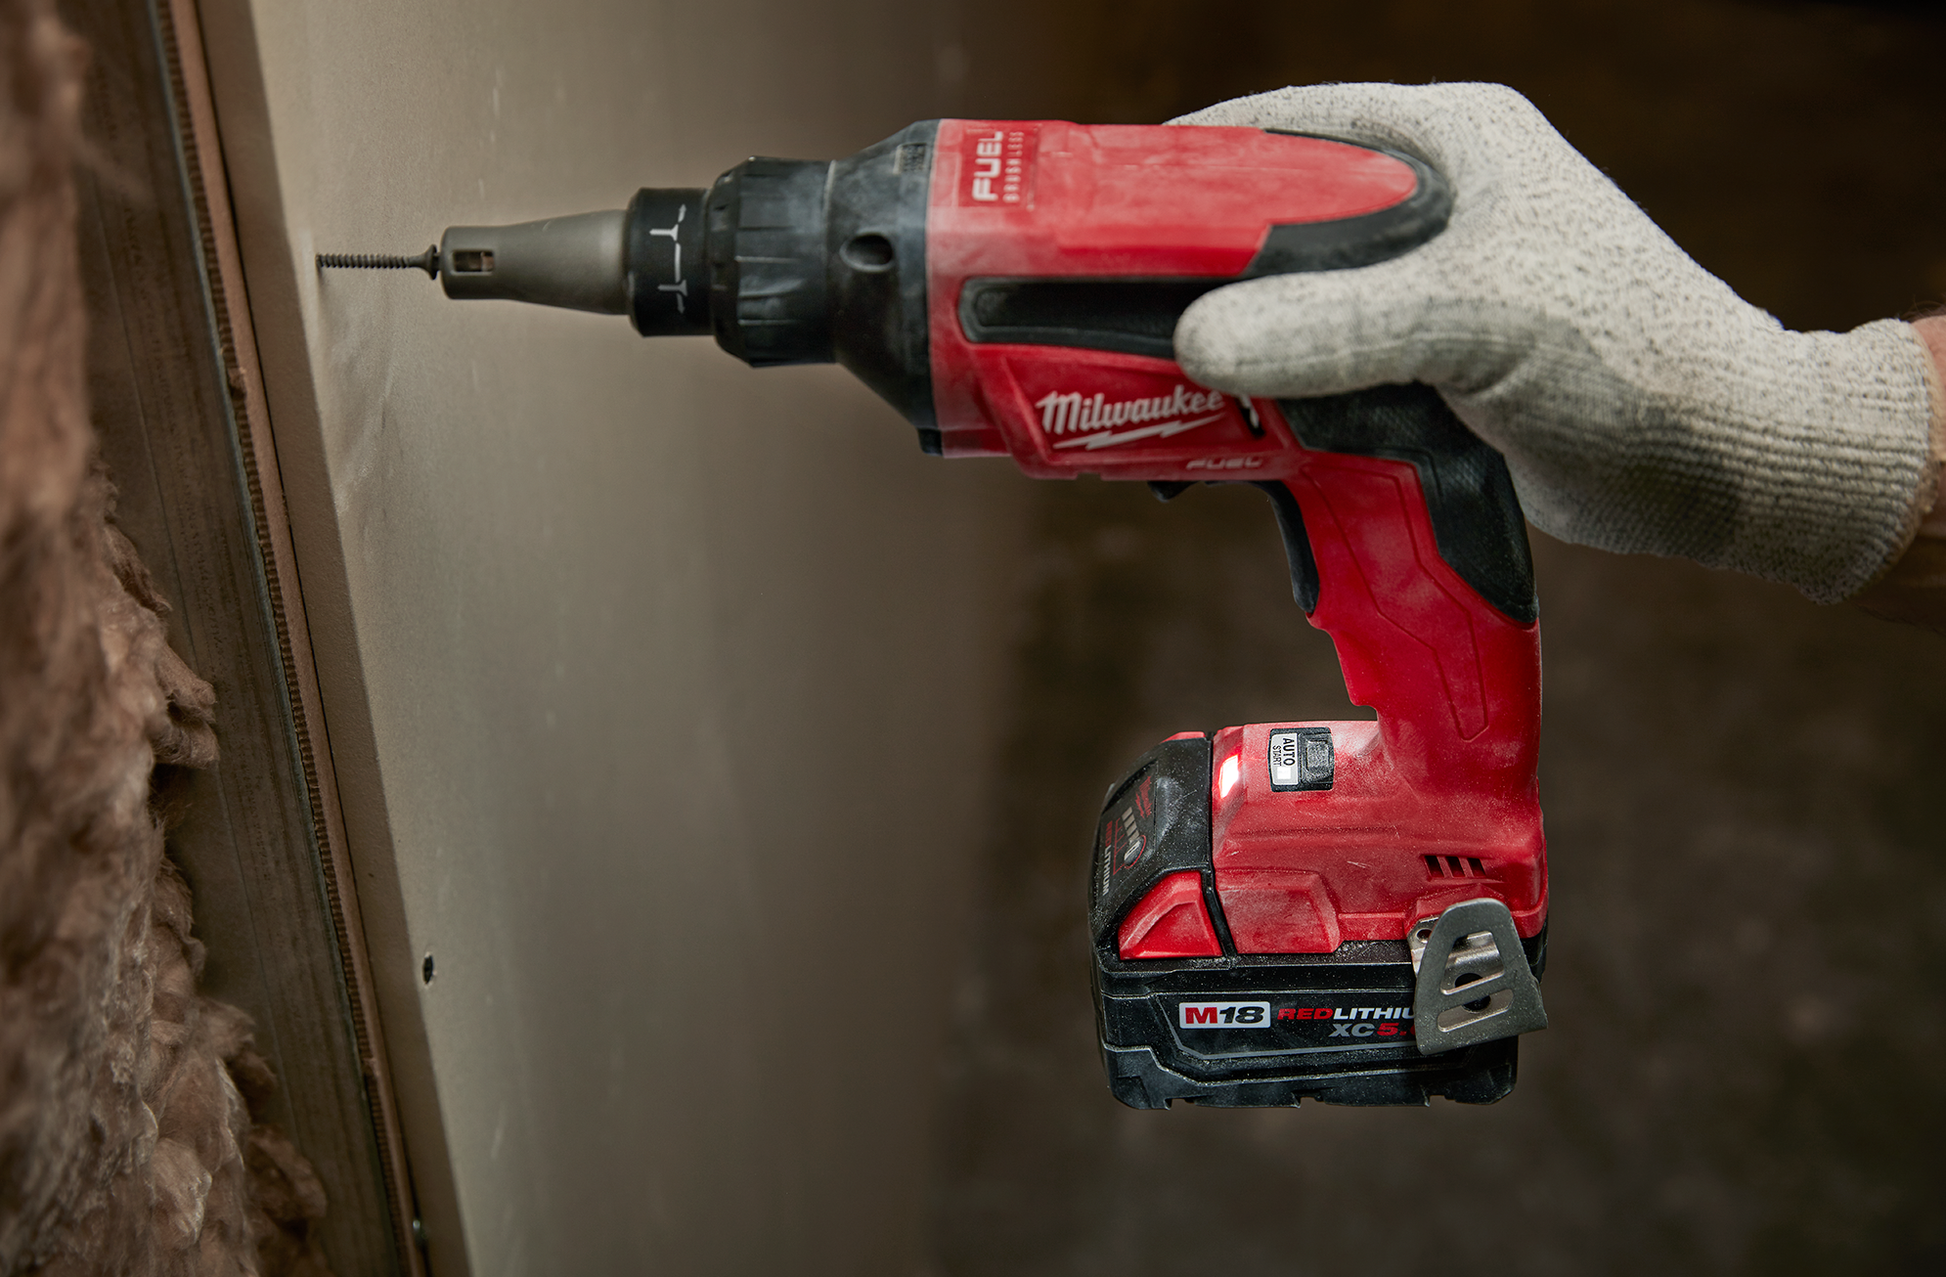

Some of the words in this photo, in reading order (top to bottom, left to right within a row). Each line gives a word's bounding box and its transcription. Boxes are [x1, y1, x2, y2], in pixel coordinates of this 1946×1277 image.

[972, 131, 1003, 201] FUEL
[1036, 385, 1226, 434] Milwaukee
[1186, 457, 1263, 469] FUEL
[1272, 745, 1281, 766] START
[1282, 737, 1296, 766] AUTO
[1185, 1006, 1265, 1024] M18
[1277, 1007, 1415, 1020] REDLITHIU
[1328, 1022, 1415, 1037] XC5.
